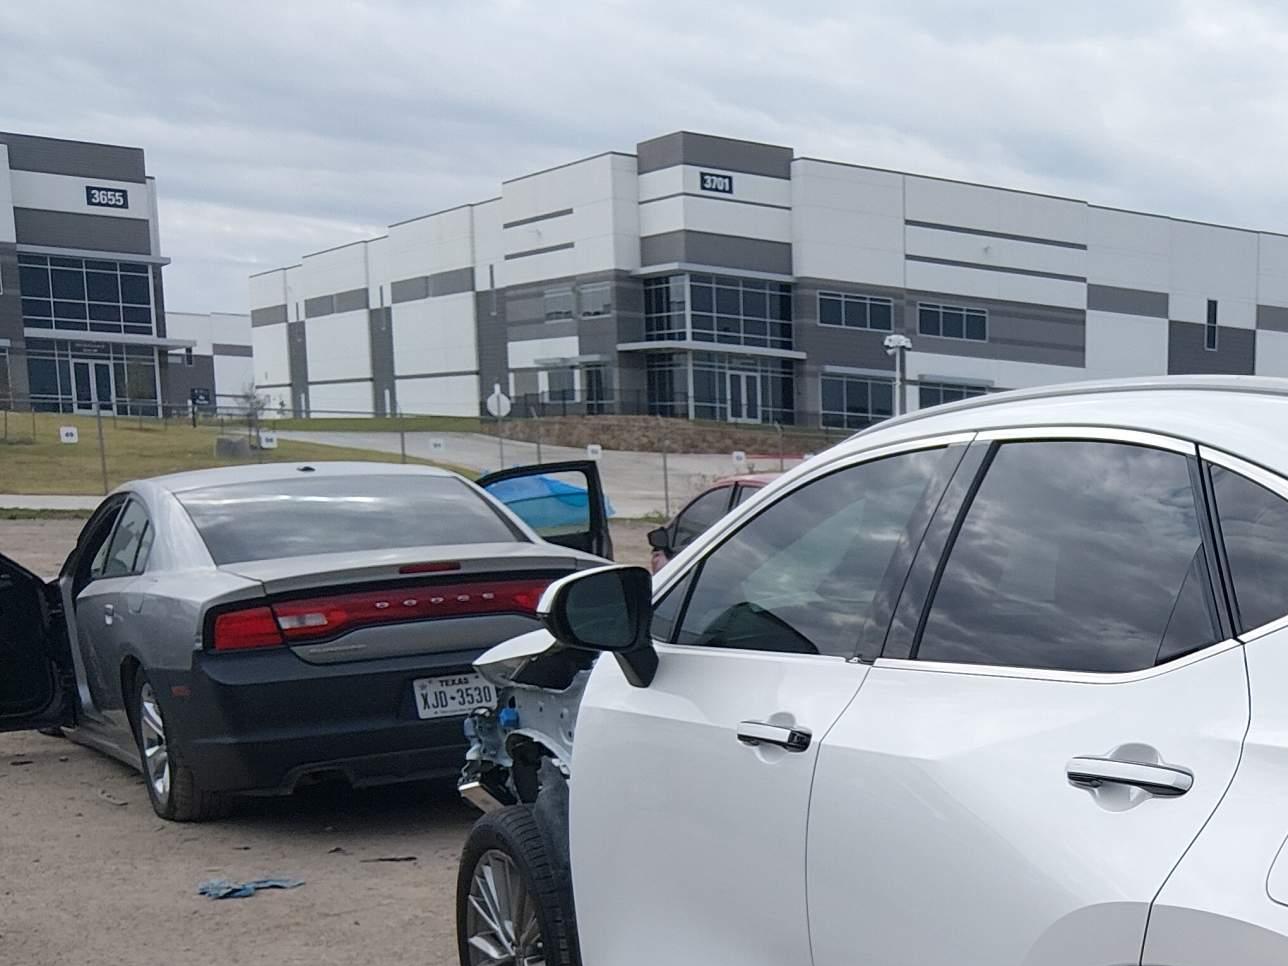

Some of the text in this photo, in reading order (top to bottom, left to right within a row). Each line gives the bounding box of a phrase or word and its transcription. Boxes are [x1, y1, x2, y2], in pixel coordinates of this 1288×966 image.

[703, 175, 730, 191] 3701
[91, 189, 124, 206] 3655
[440, 677, 469, 687] TEXAS
[421, 685, 492, 710] XJD-3530
